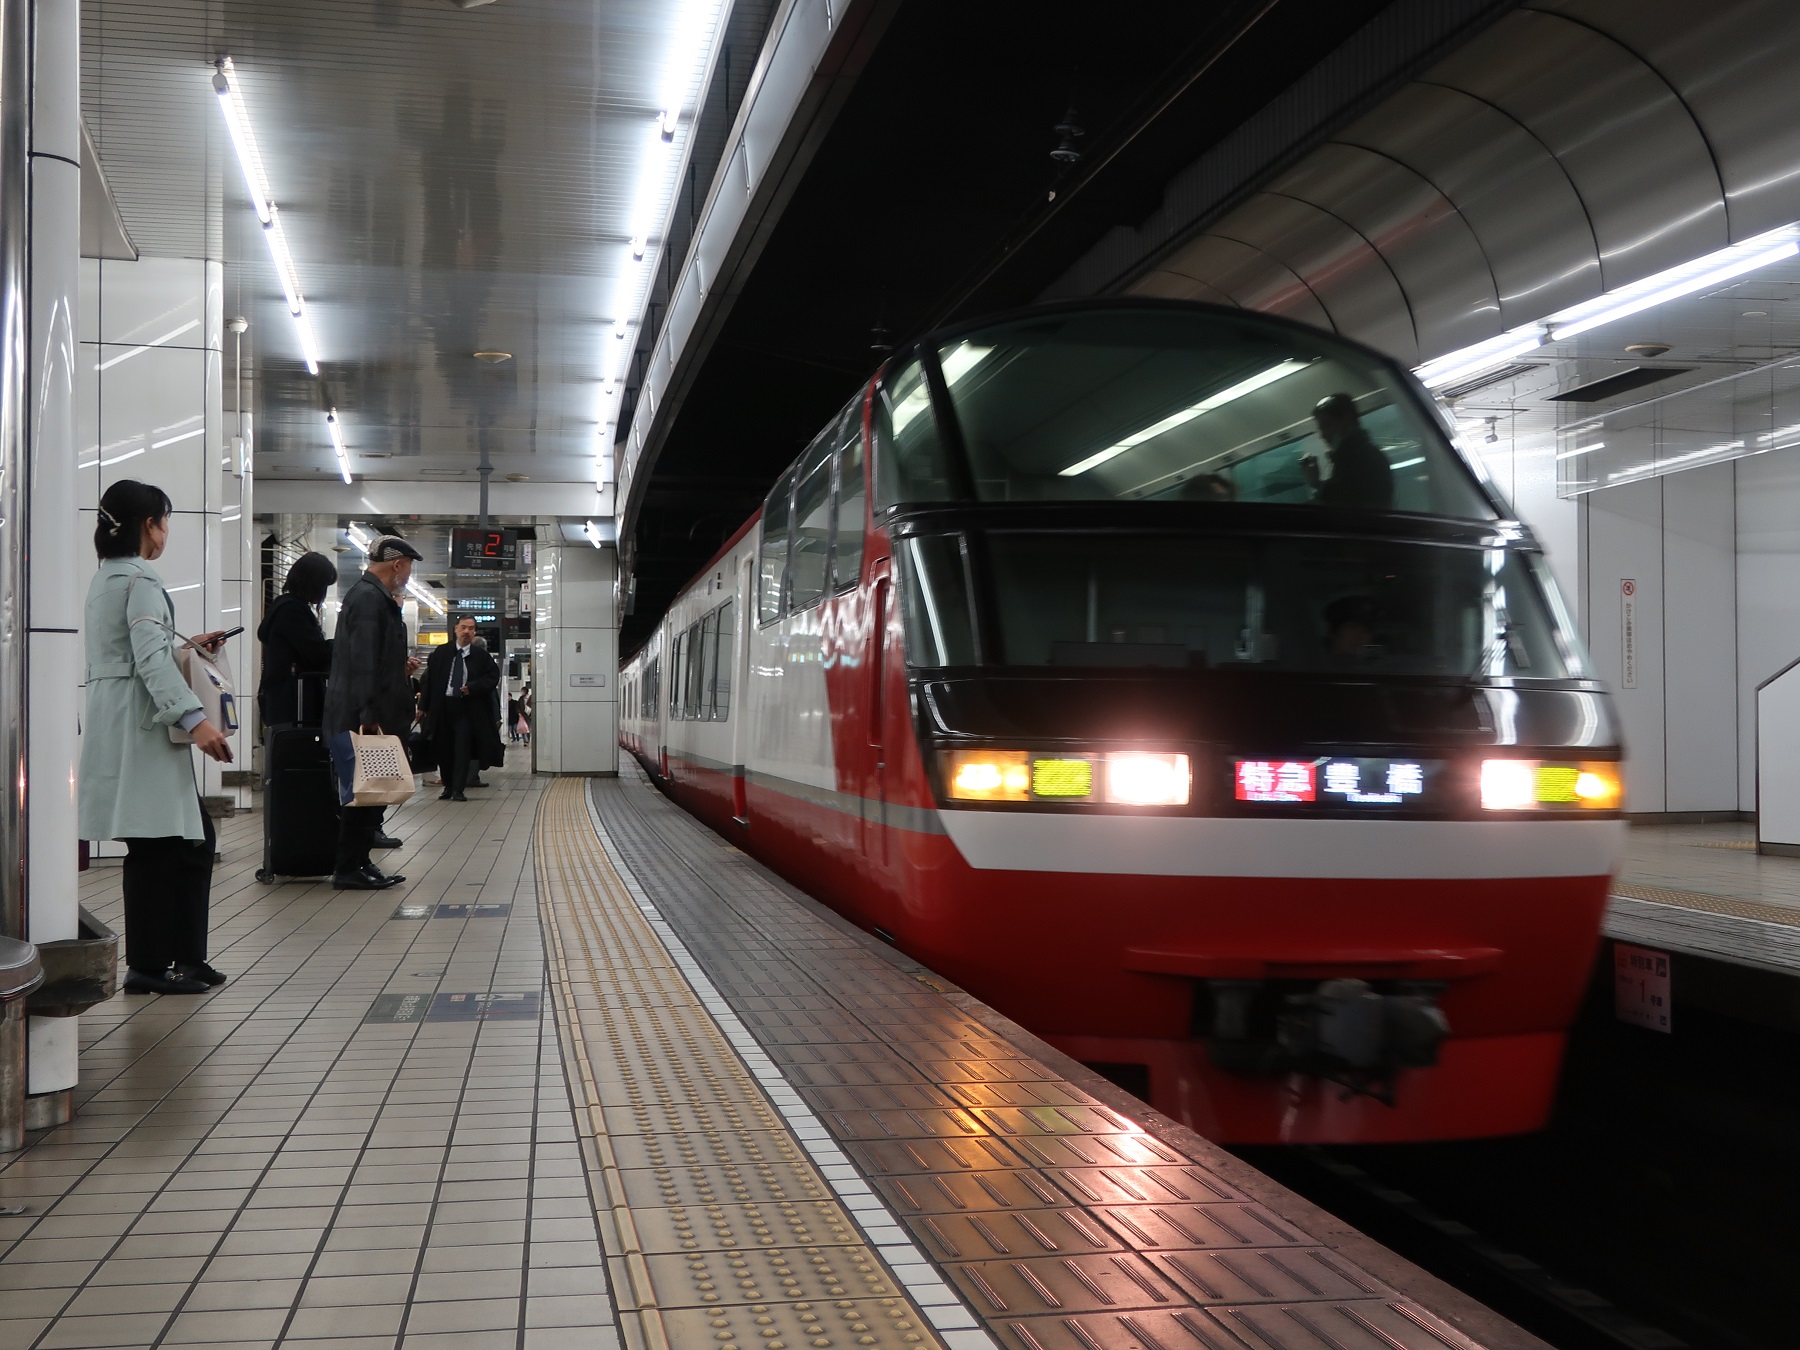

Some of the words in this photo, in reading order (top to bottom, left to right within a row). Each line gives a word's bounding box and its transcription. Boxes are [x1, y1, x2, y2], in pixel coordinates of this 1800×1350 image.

[485, 534, 500, 555] 2
[1238, 761, 1312, 792] 特急
[1323, 762, 1424, 794] 豊橋
